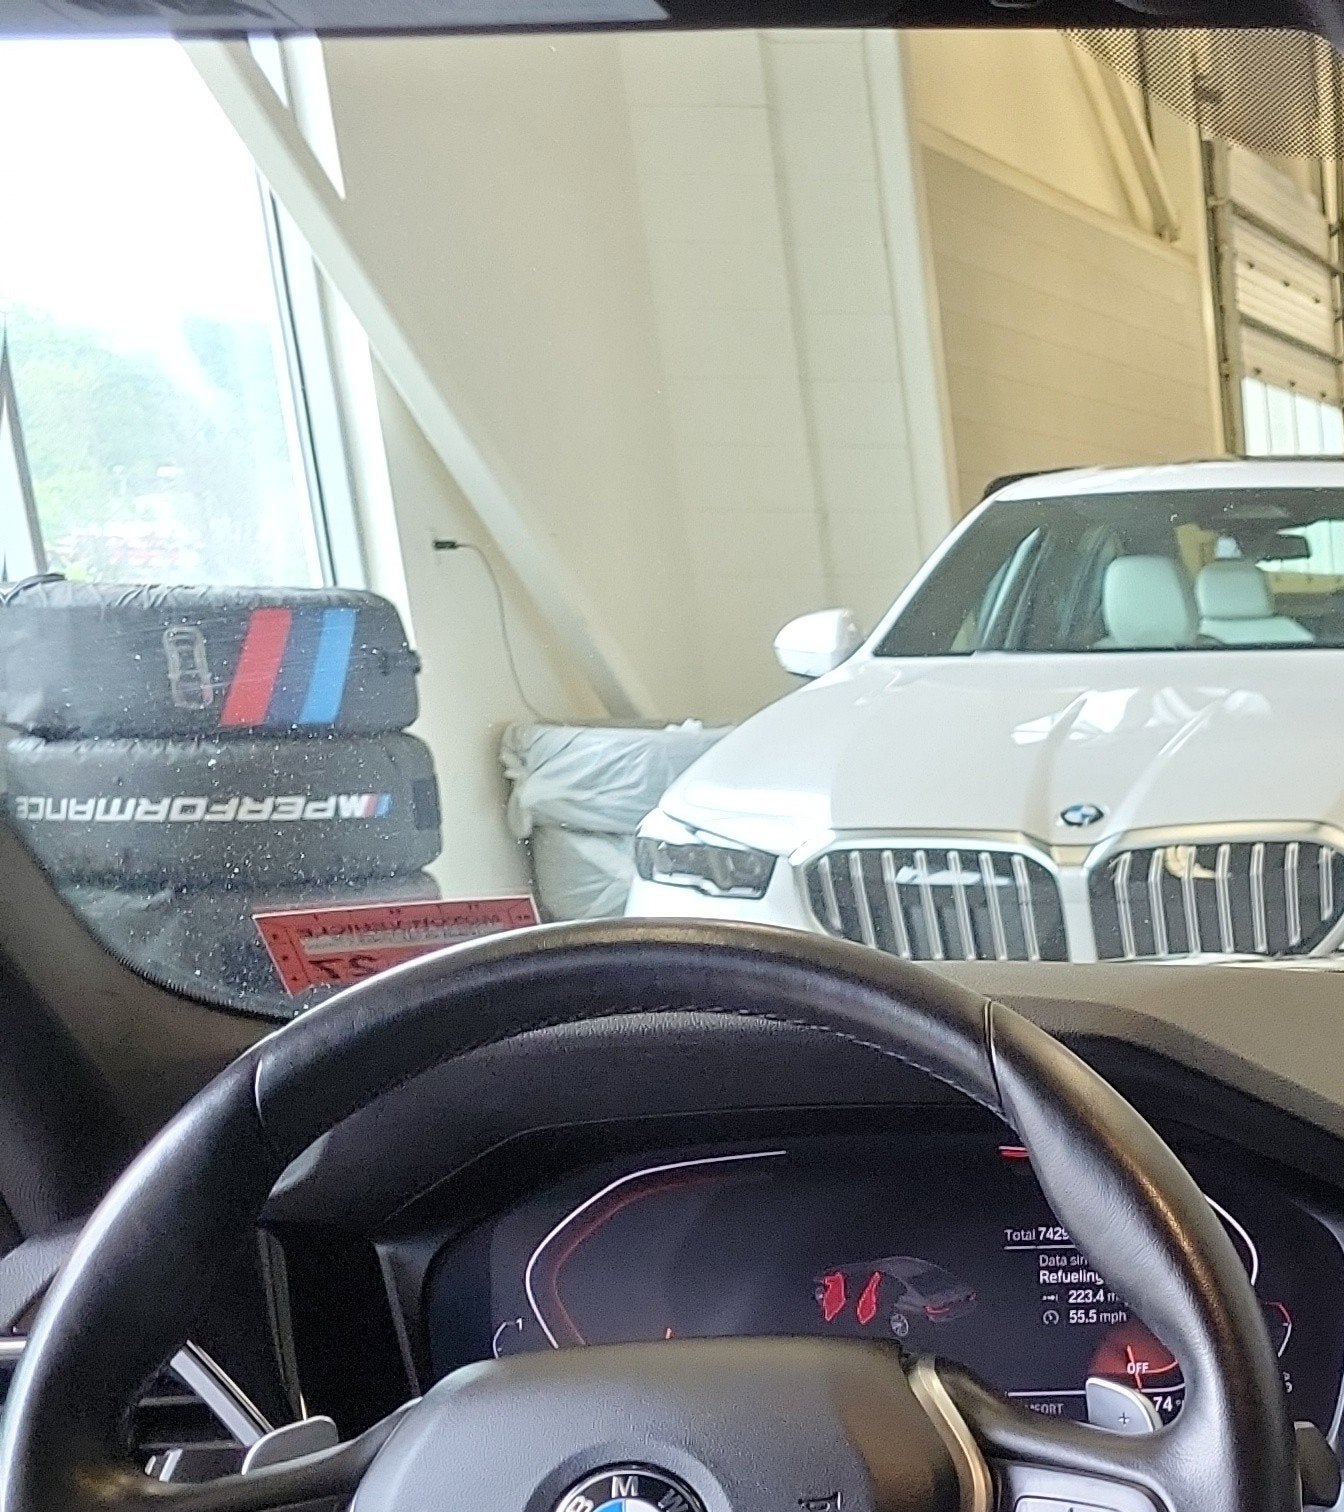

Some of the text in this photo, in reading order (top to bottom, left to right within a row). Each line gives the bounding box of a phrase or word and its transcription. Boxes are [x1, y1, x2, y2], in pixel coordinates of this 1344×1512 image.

[1004, 1228, 1036, 1241] Total
[1039, 1254, 1068, 1267] Data
[1039, 1269, 1104, 1285] Refueling
[1068, 1289, 1105, 1304] 223.4
[1069, 1310, 1128, 1325] 55.5 mph
[1127, 1362, 1150, 1375] OFF
